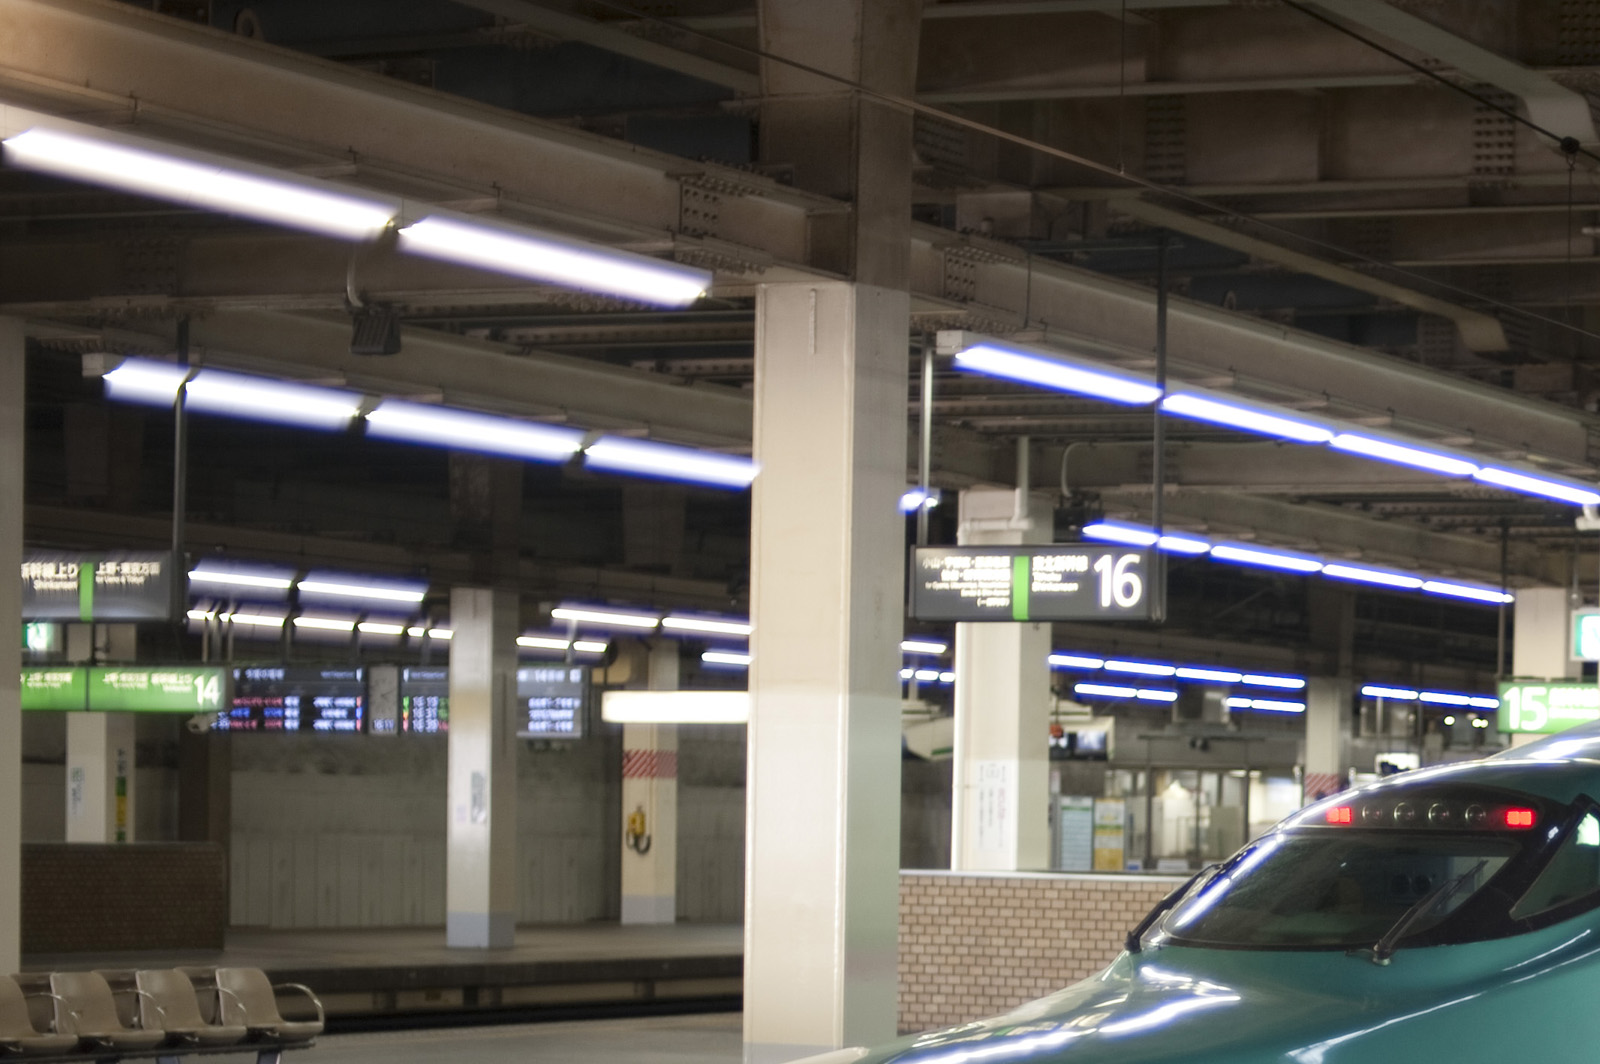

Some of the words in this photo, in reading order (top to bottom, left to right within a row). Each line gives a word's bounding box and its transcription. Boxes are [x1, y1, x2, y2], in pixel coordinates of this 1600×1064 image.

[1094, 554, 1142, 608] 16
[194, 675, 220, 706] 14
[1503, 686, 1547, 731] 15
